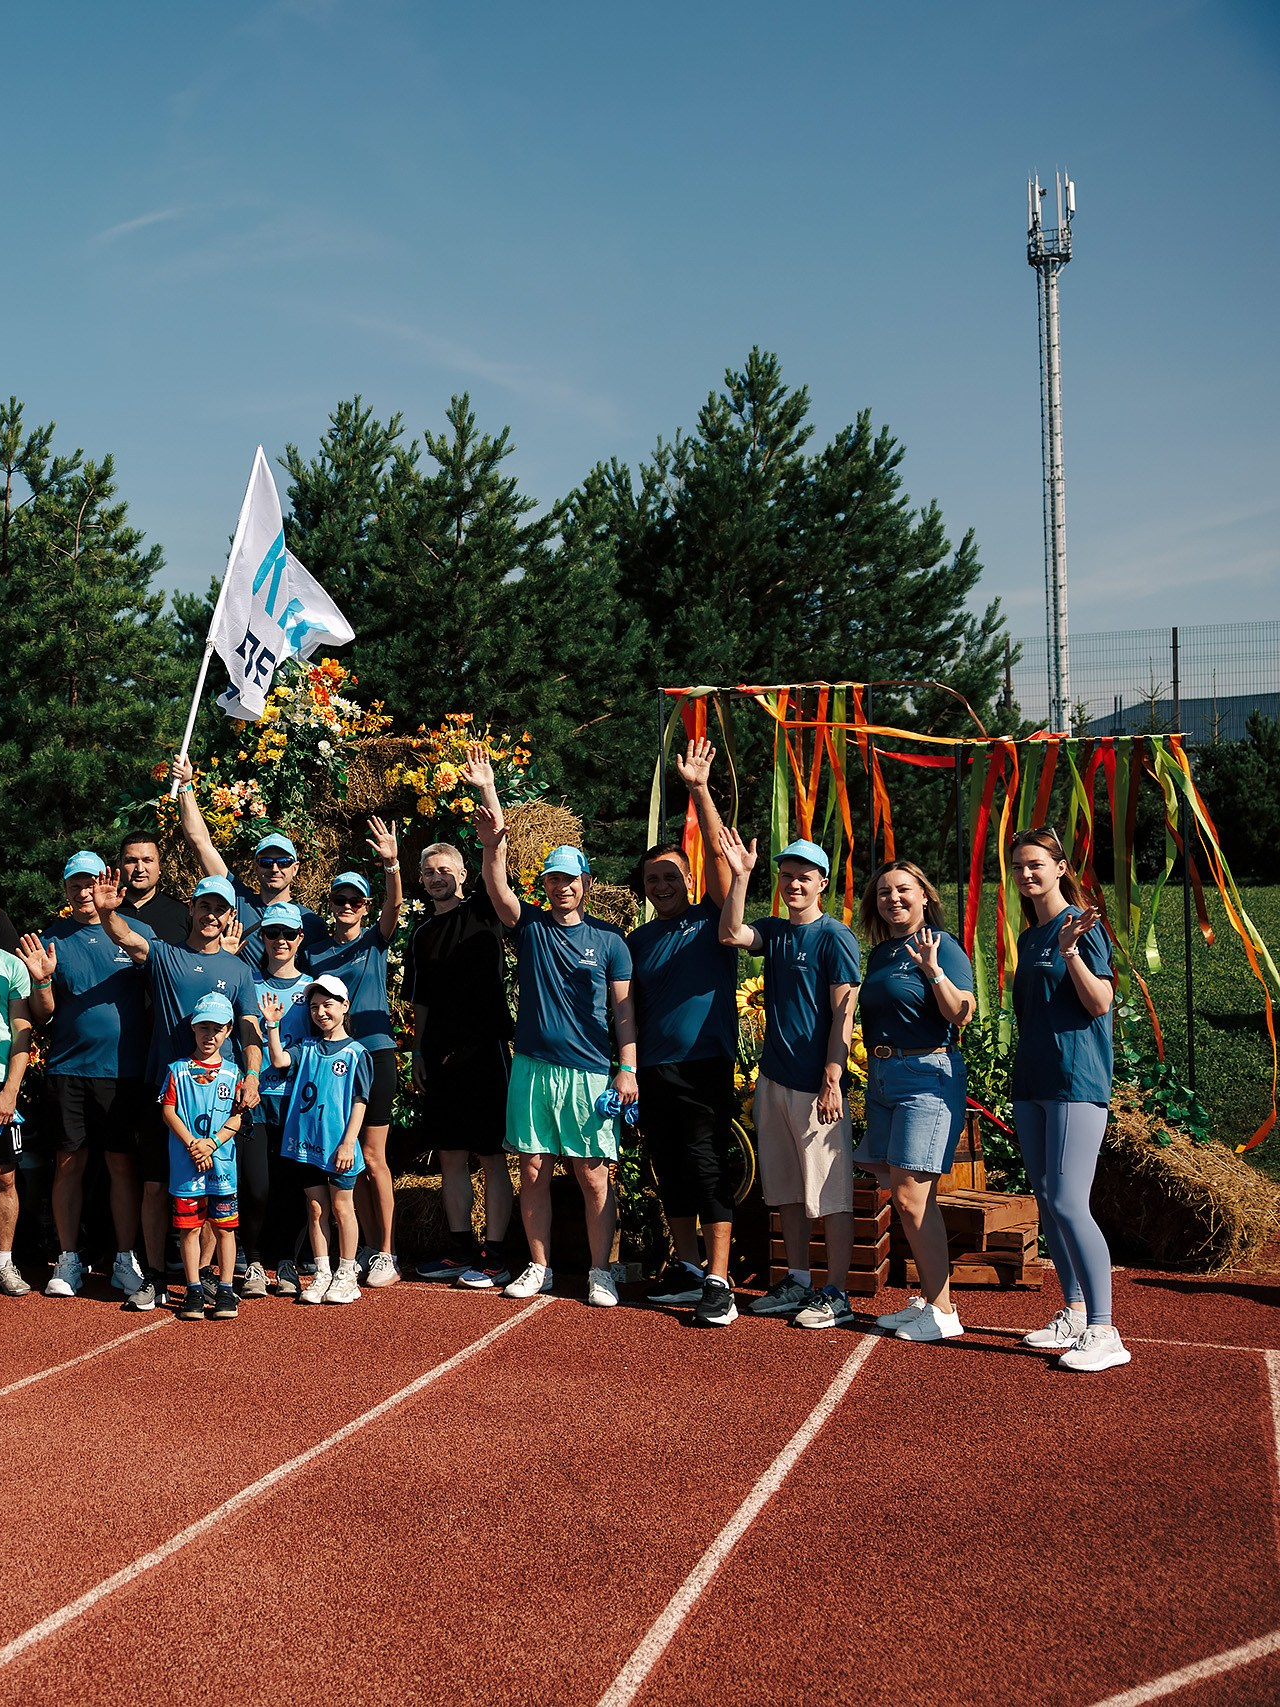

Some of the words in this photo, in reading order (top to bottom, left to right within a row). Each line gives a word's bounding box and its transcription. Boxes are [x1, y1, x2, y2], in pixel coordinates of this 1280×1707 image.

[265, 1074, 294, 1083] КОМО
[300, 1082, 318, 1114] 9
[10, 1125, 22, 1150] 10
